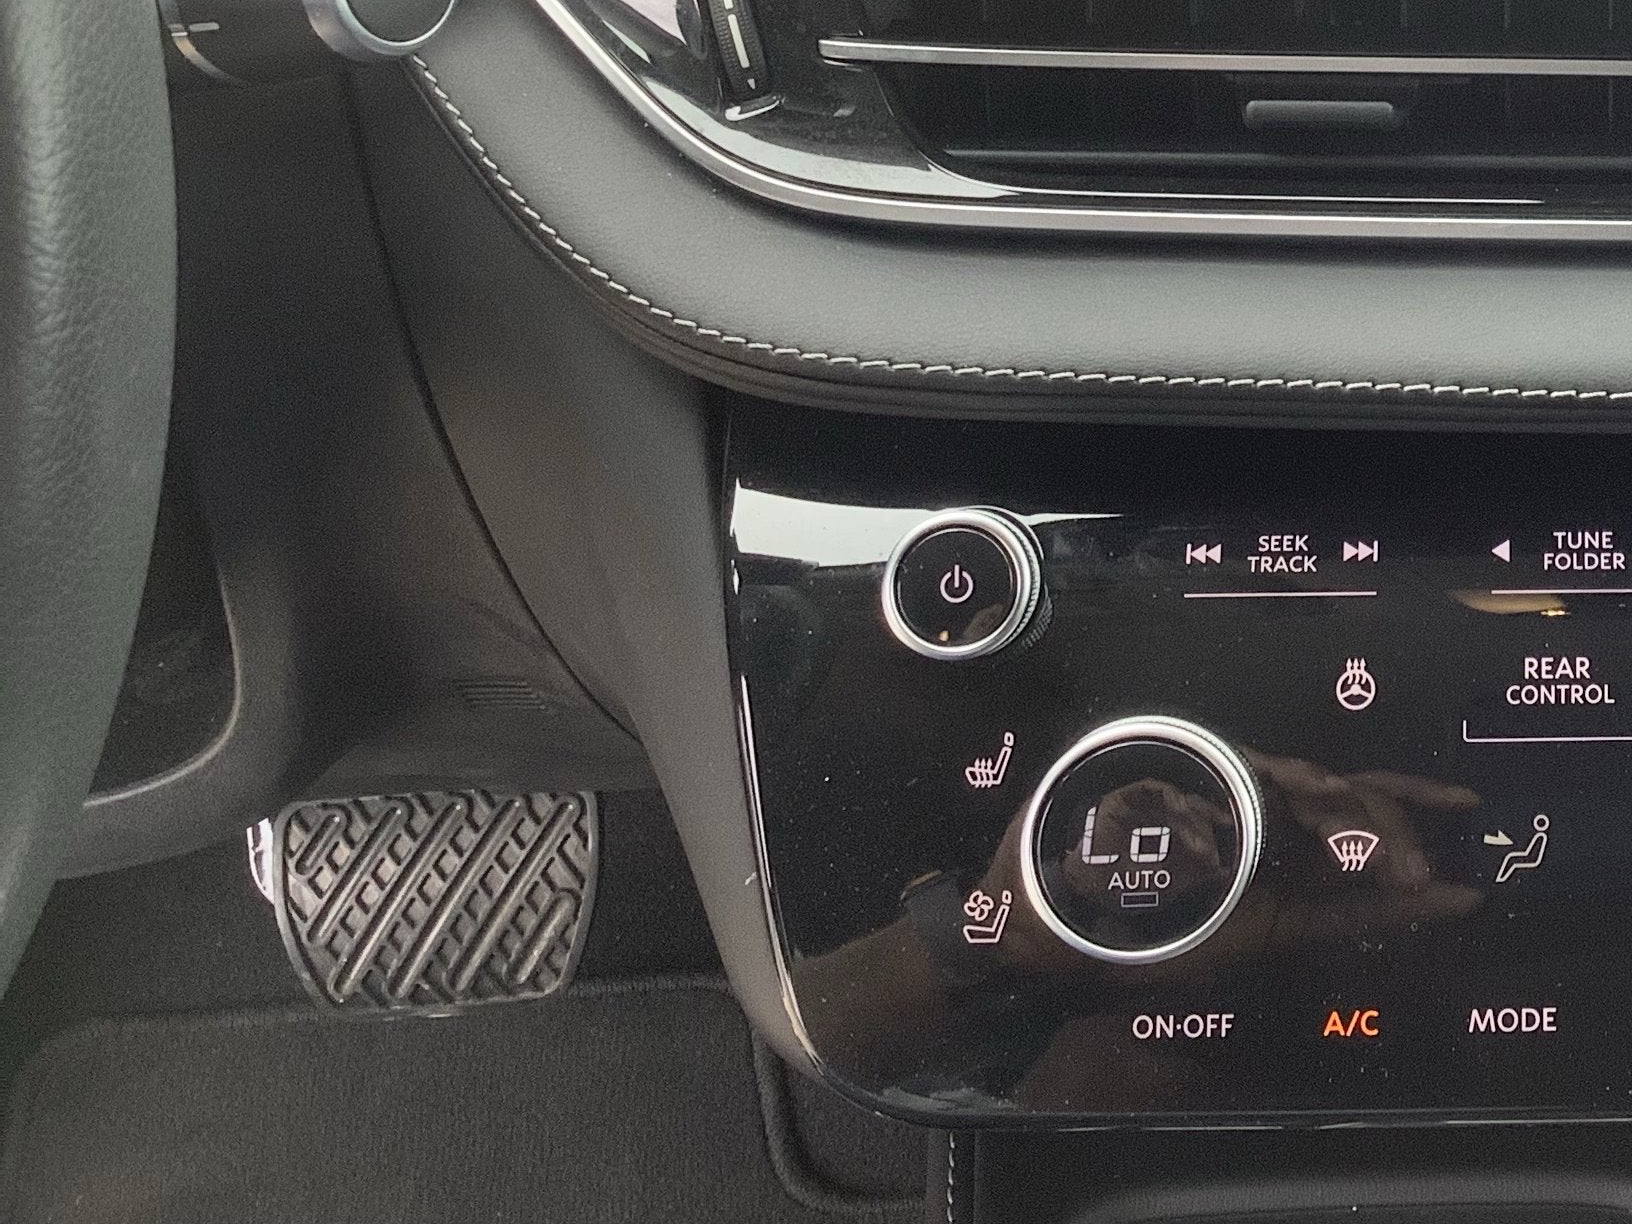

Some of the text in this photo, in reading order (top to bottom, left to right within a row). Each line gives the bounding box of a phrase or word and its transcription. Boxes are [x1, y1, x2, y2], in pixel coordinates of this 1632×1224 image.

[1258, 534, 1310, 553] SEEK
[1553, 531, 1614, 550] TUNE
[1247, 555, 1318, 574] TRACK
[1543, 551, 1627, 571] FOLDER
[1523, 657, 1590, 681] REAR
[1506, 682, 1616, 707] CONTROL
[1108, 869, 1172, 890] AUTO
[1323, 1010, 1380, 1037] A/C
[1467, 1007, 1557, 1033] MODE
